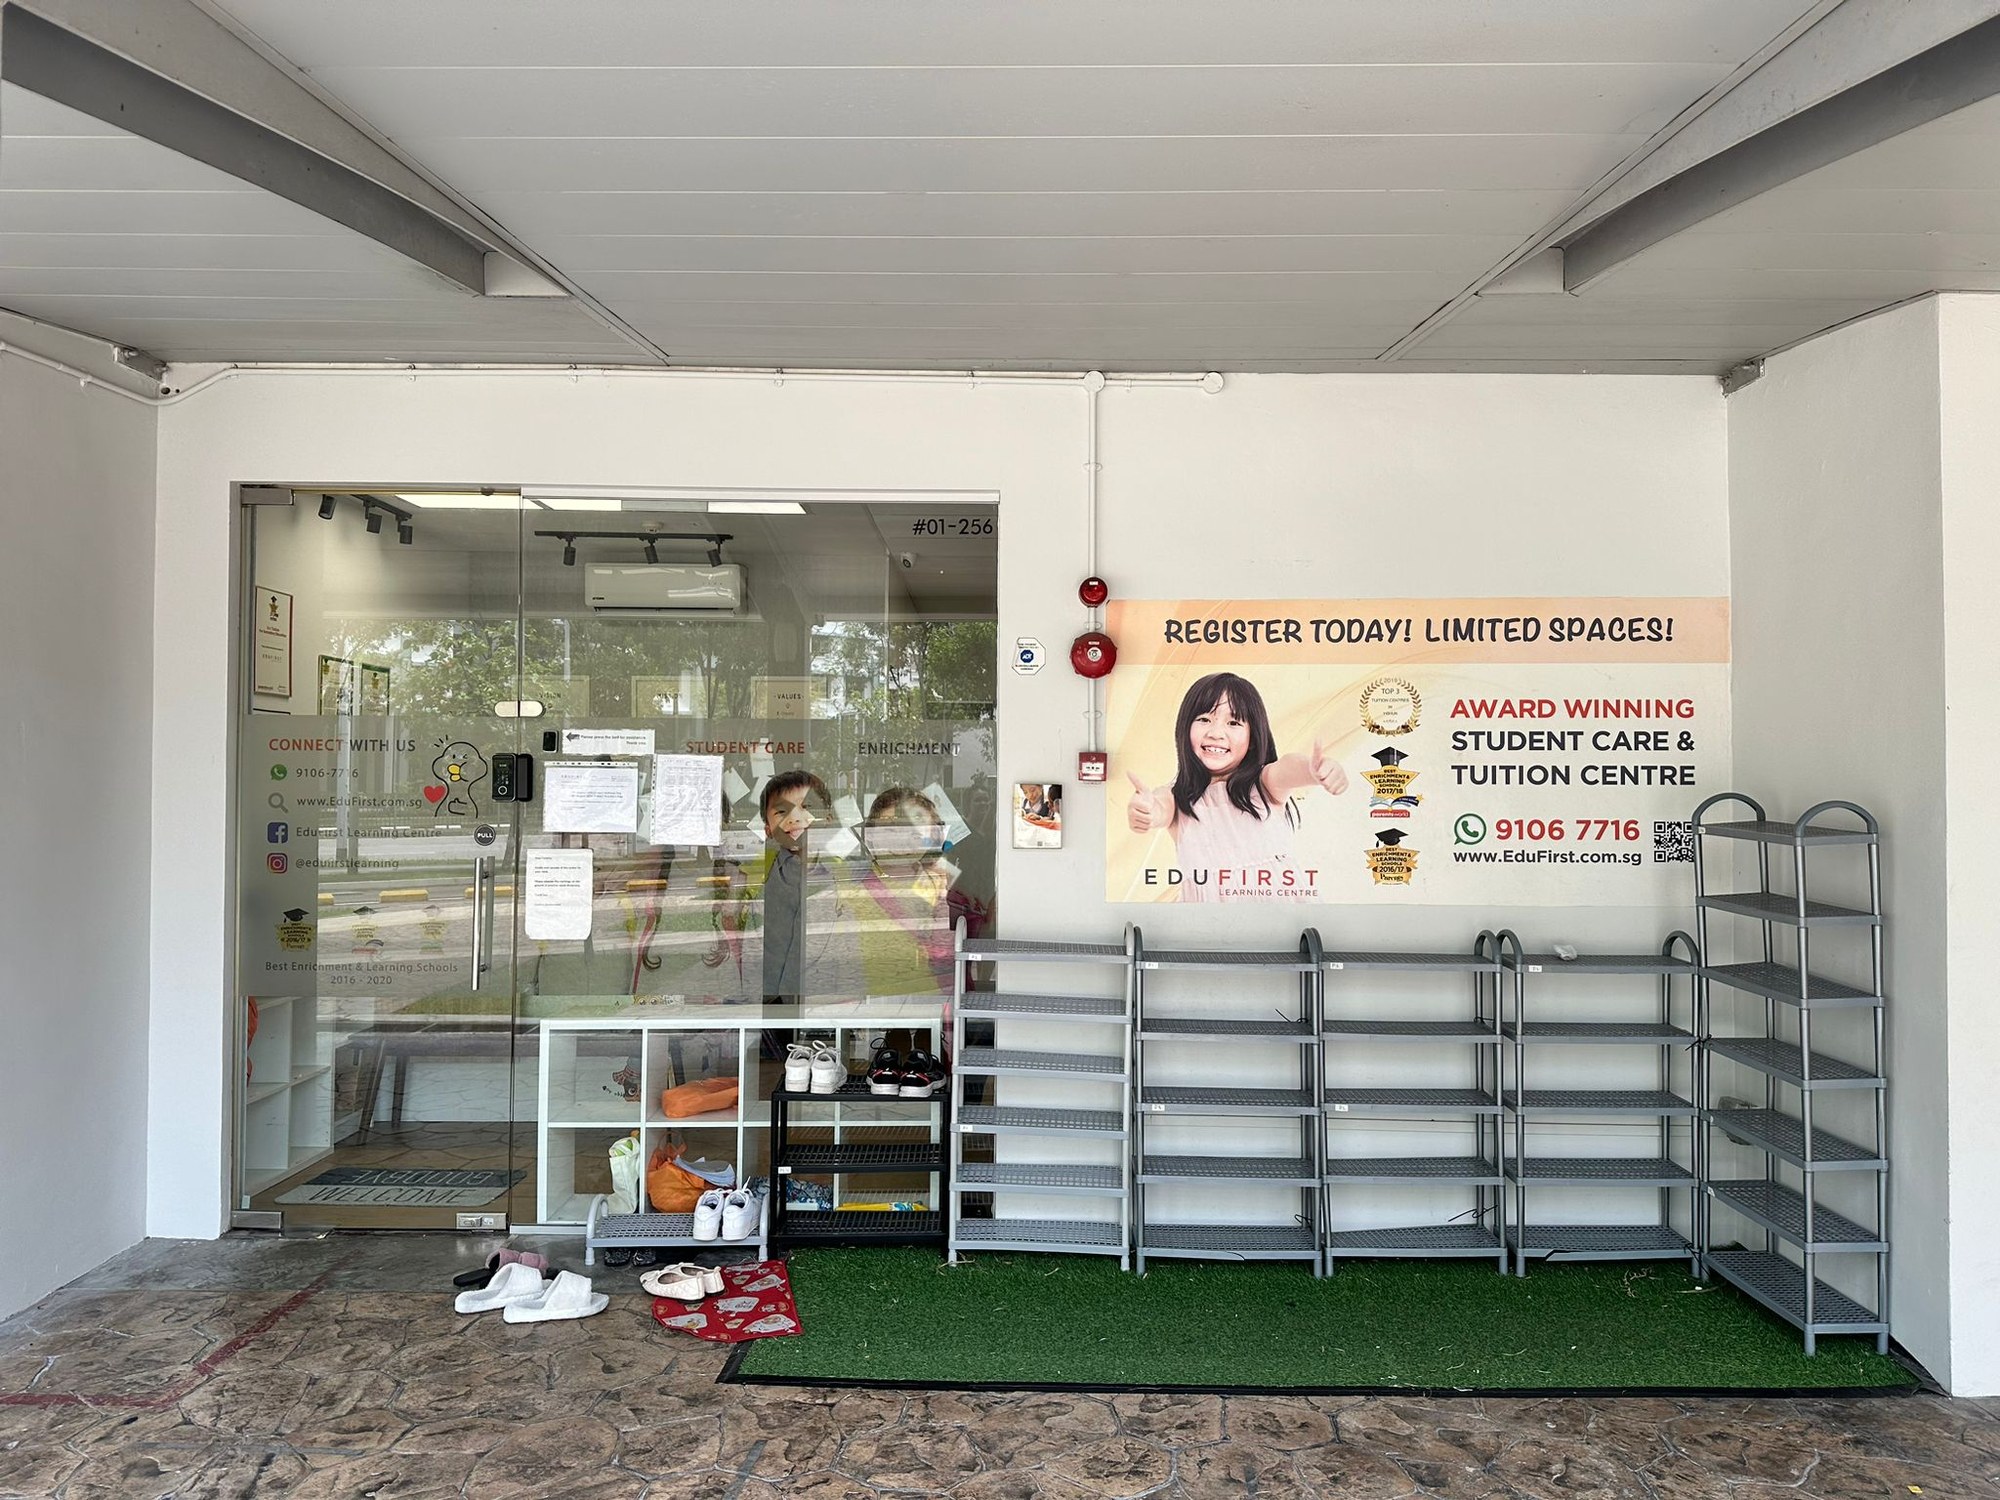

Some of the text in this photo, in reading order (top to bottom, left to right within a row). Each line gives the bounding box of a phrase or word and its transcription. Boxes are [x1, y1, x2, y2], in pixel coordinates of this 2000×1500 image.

[912, 518, 993, 536] #01-256
[1164, 617, 1674, 645] REGISTER TODAY! LIMITED SPACES!
[1450, 698, 1696, 719] AWARD WINNING
[269, 738, 416, 752] CONNECT WITH US
[685, 741, 806, 755] STUDENT CARE
[858, 741, 961, 756] ENRICHMENT
[1451, 730, 1696, 752] STUDENT CARE &
[296, 768, 359, 778] 9106-776
[1451, 764, 1696, 786] TUITION CENTRE
[296, 796, 422, 809] www.EduFirst.com.sg
[347, 827, 399, 839] Learning
[403, 827, 443, 838] Centre
[1495, 819, 1641, 842] 9106 7716
[1453, 849, 1642, 866] www.EduFirst.com.sg
[1145, 869, 1319, 886] EDUFIRST
[265, 962, 458, 973] Best Enrichment & Learning Schools
[330, 976, 356, 985] 2016
[367, 976, 393, 985] 2020
[342, 1169, 494, 1185] GOODBYE
[309, 1186, 476, 1204] WELCOME
